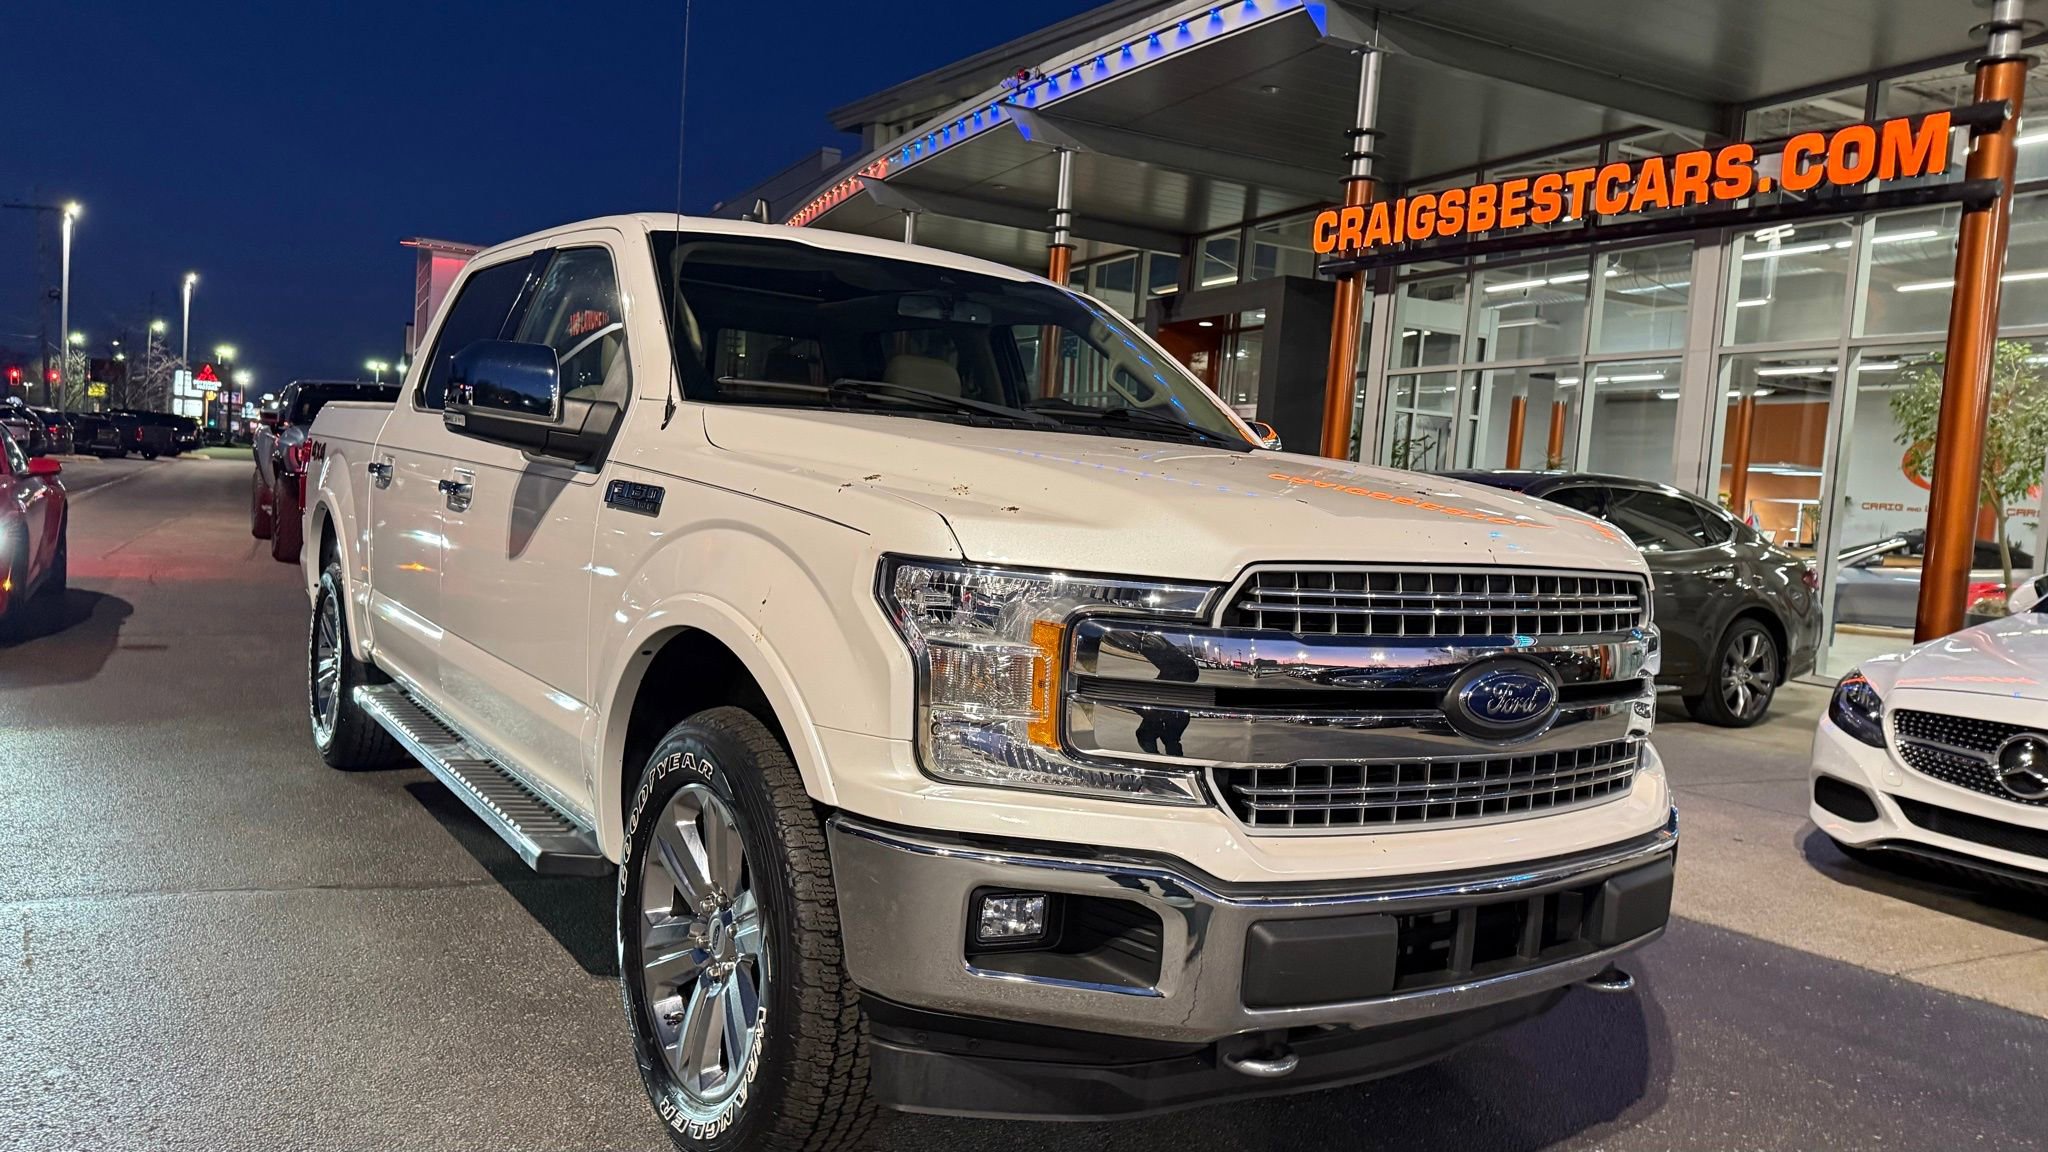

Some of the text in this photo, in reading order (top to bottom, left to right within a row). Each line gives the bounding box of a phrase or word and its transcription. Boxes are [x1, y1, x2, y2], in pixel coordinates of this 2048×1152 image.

[1312, 110, 1952, 254] CRAIGSBESTCARS.COM
[1487, 682, 1545, 714] Ford
[619, 752, 714, 897] GOODYEAR
[659, 1005, 767, 1140] WRANGLER
